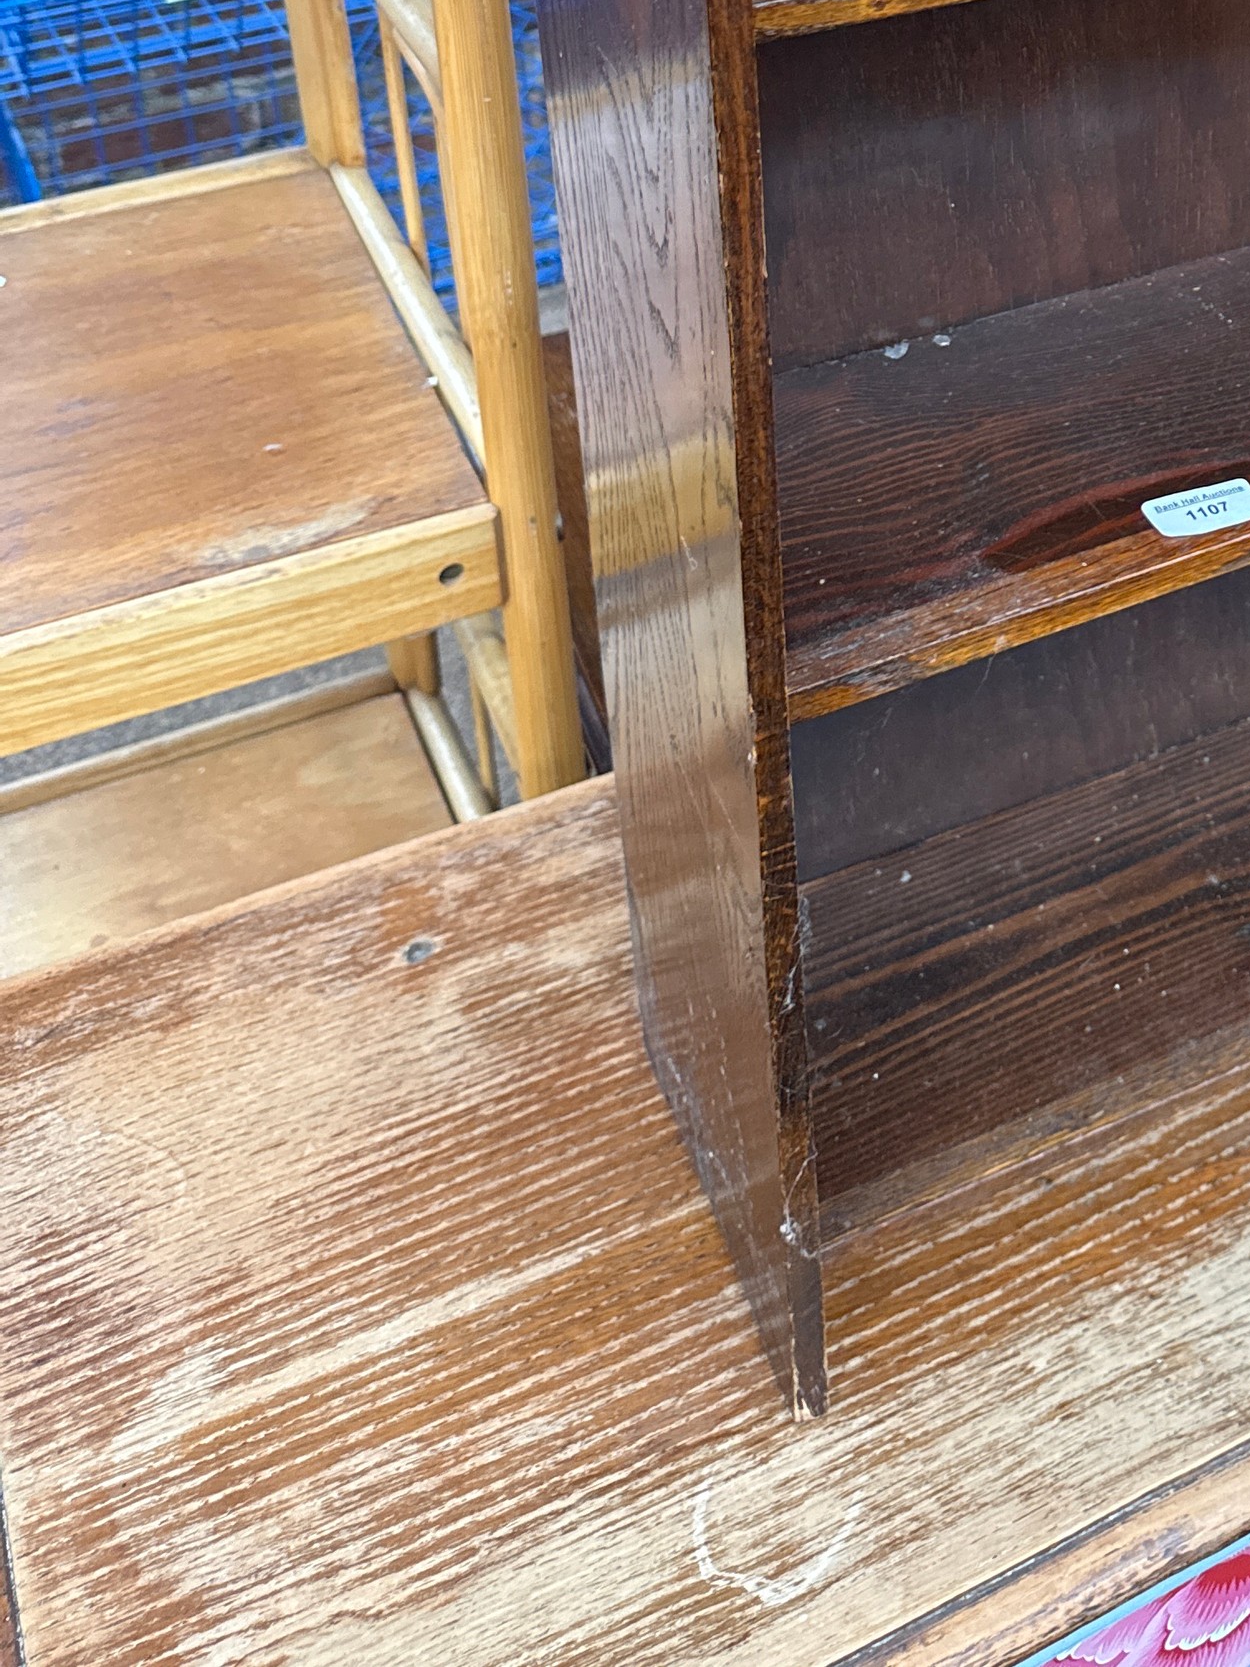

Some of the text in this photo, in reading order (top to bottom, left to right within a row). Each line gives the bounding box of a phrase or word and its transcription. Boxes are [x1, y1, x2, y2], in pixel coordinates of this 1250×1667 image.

[1154, 484, 1245, 514] Bank Hall Auctions
[1185, 500, 1229, 522] 1107
